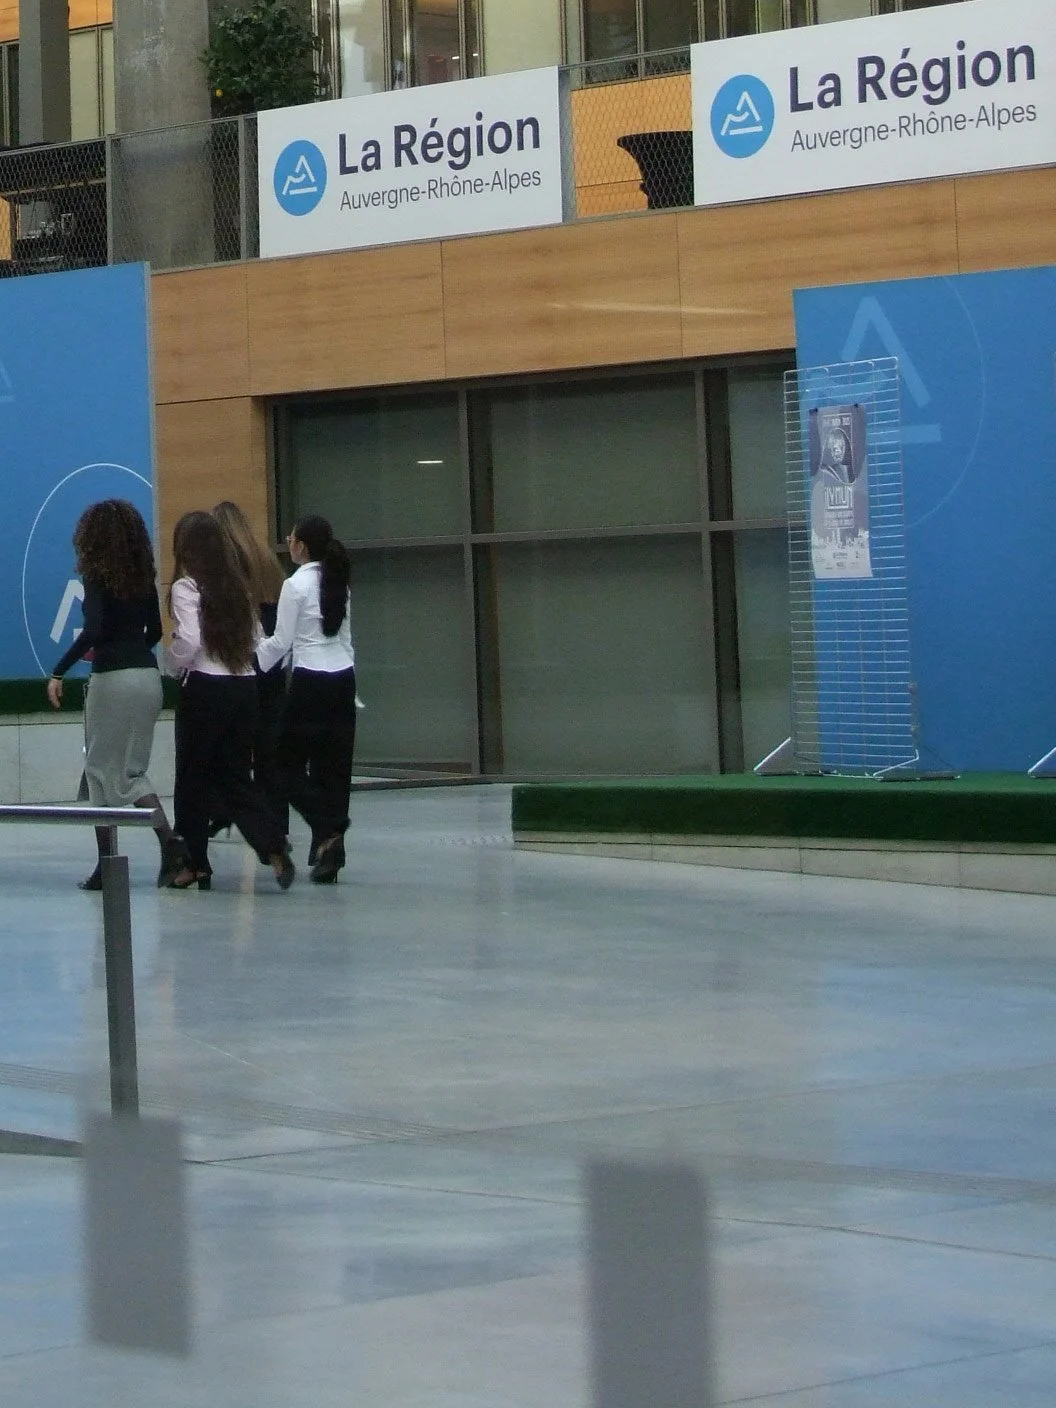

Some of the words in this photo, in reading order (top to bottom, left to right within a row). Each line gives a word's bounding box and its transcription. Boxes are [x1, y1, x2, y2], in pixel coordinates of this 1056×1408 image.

[789, 66, 842, 113] La
[857, 40, 1036, 106] Région
[339, 133, 382, 176] La
[394, 111, 541, 171] Région
[790, 102, 1038, 152] Auvergne-Rhône-Alpes
[340, 168, 542, 211] Auvergne-Rhône-Alpes
